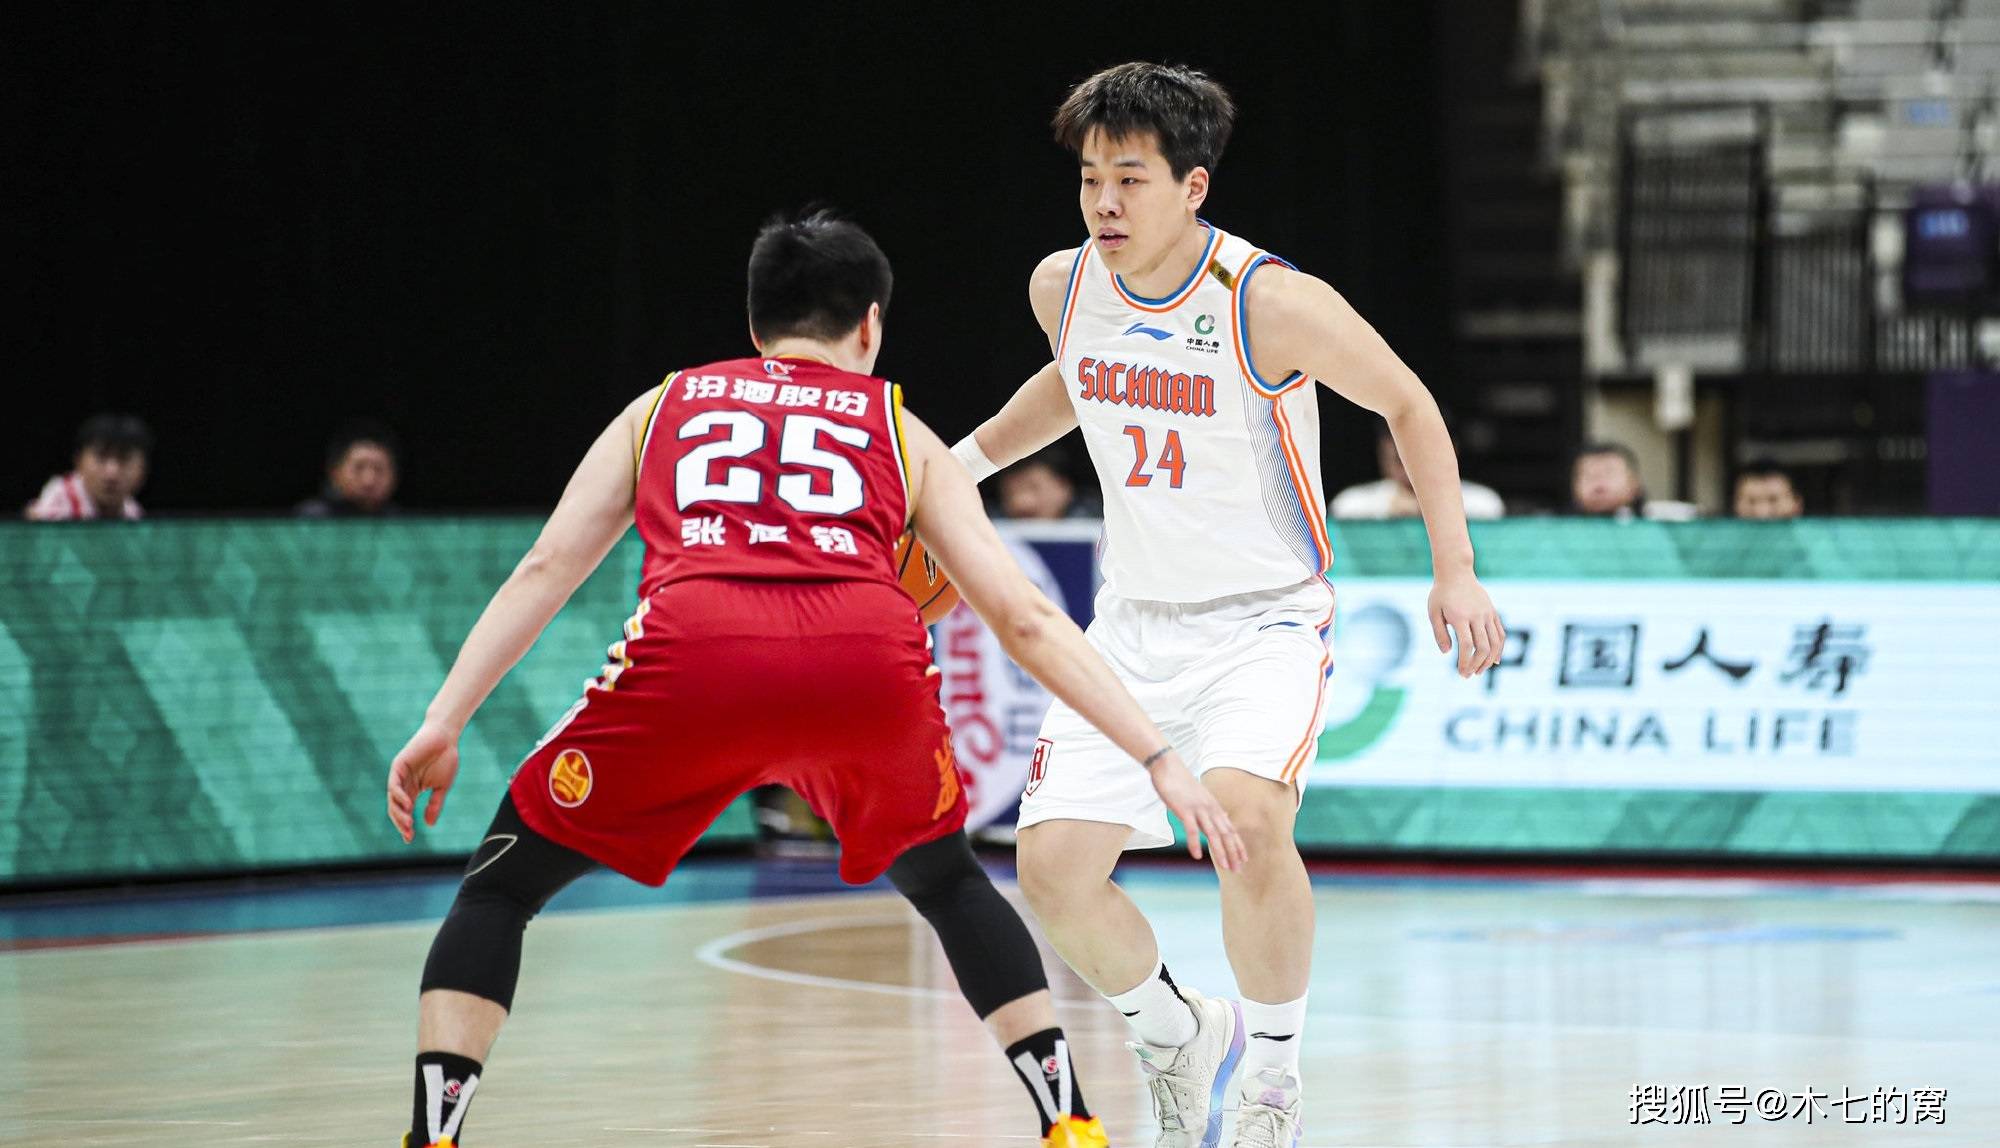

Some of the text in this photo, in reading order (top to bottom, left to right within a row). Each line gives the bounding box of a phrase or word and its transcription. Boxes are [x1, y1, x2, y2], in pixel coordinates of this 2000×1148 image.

[682, 374, 869, 417] 汾酒股份
[1077, 356, 1217, 418] SICHUAN
[674, 410, 872, 516] 25
[1122, 424, 1187, 489] 24
[1444, 708, 1859, 756] CHINA LIFE
